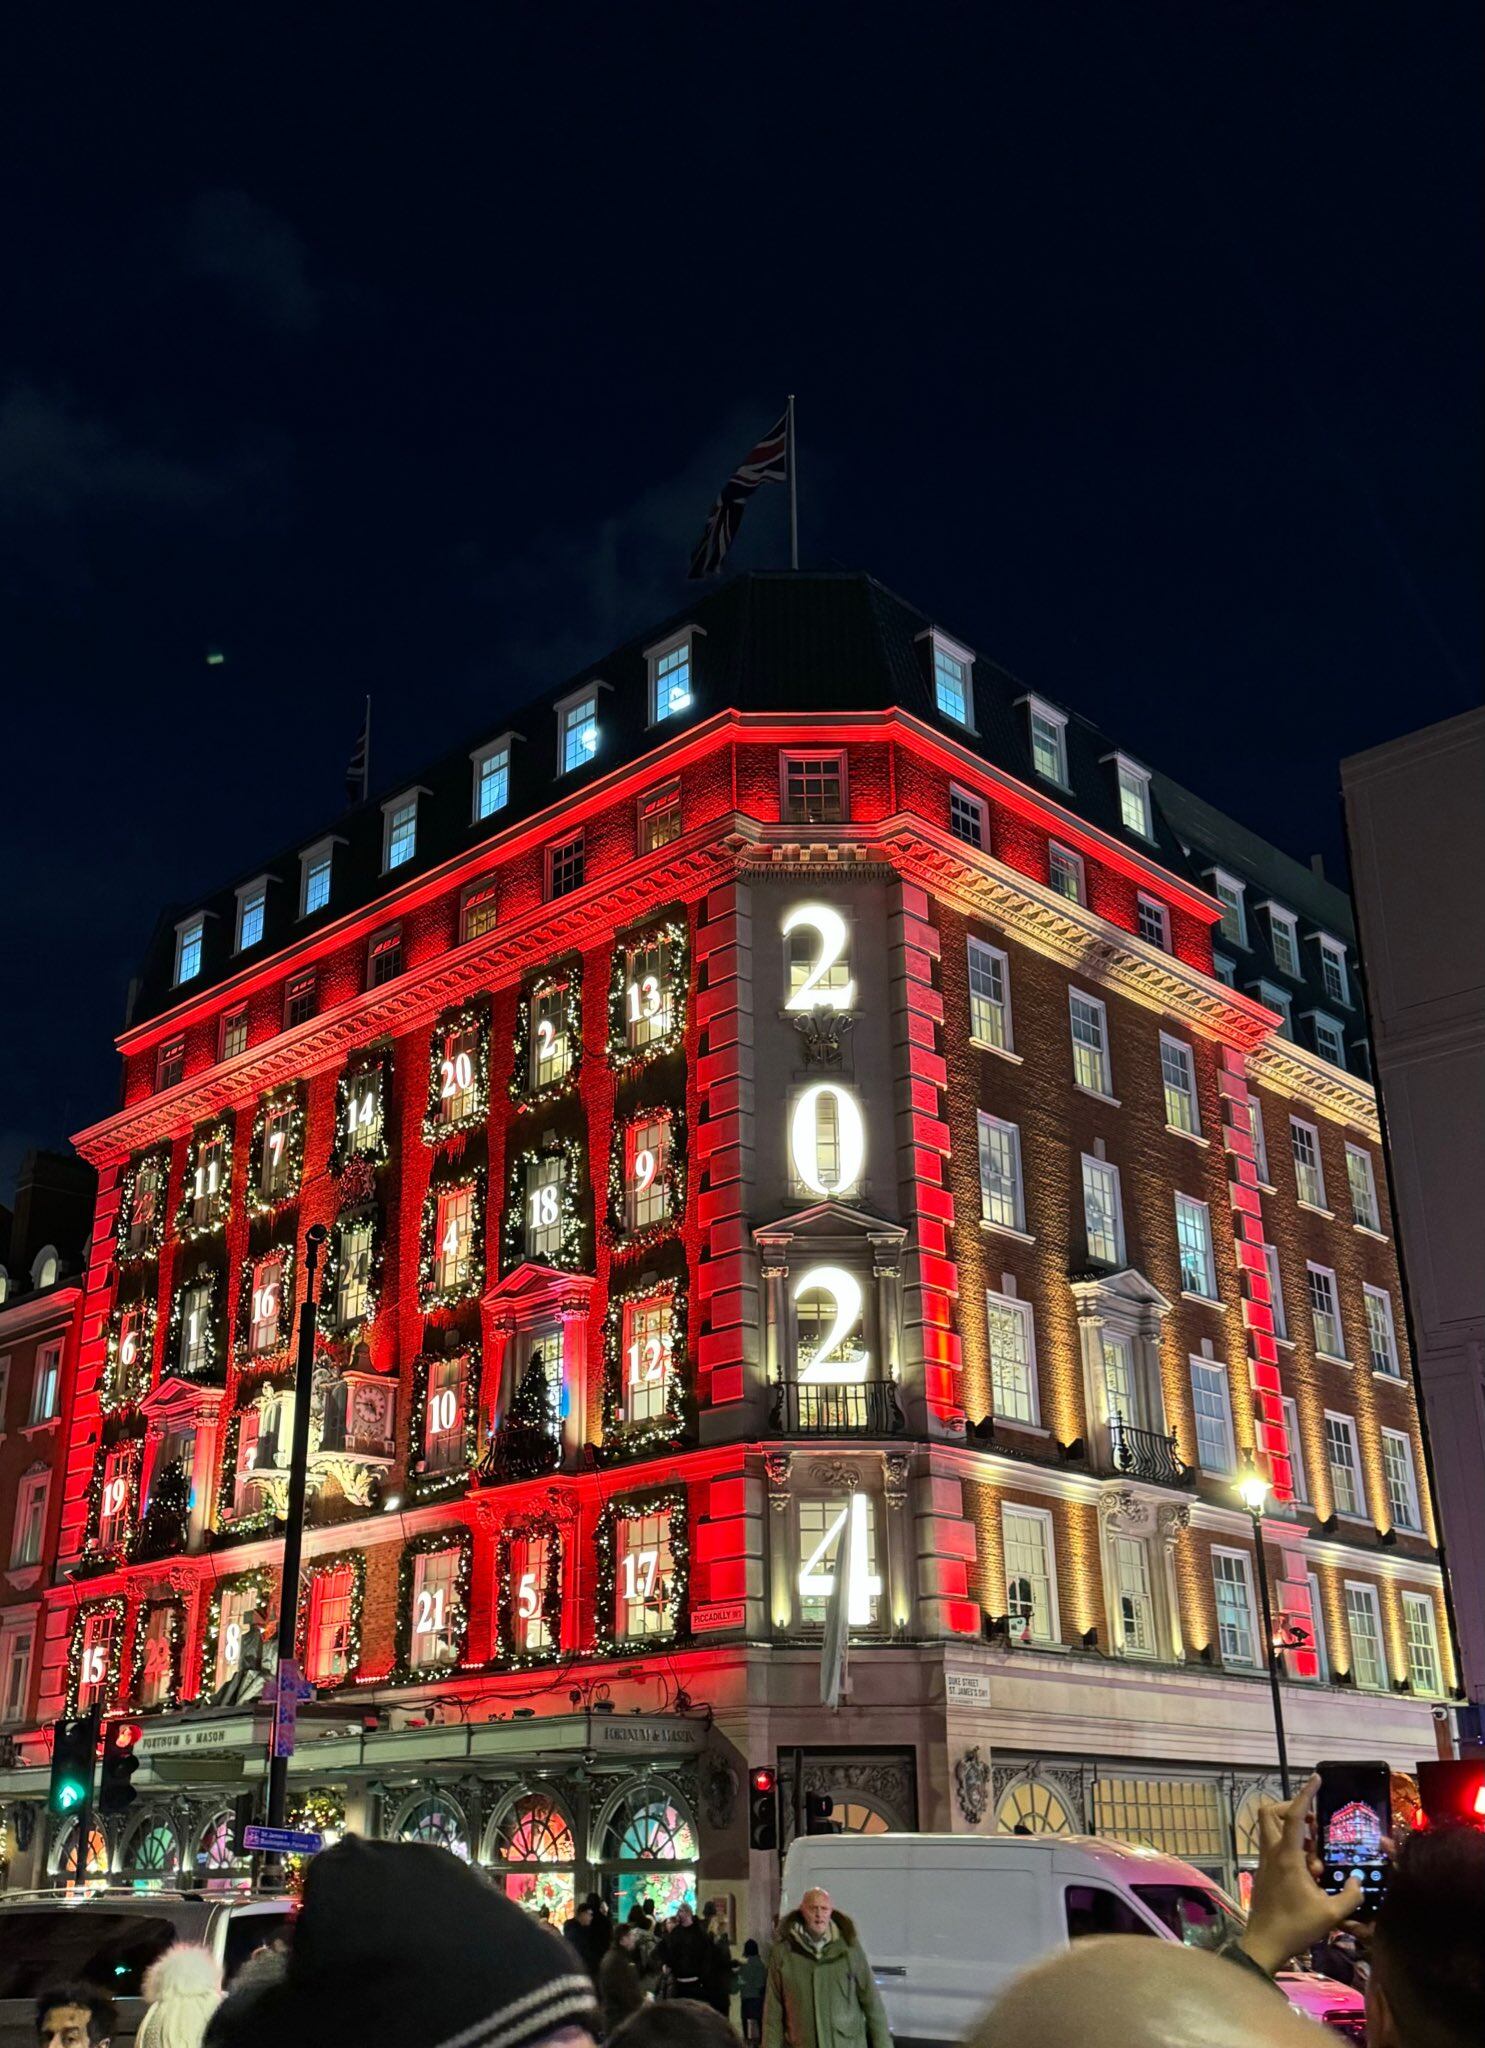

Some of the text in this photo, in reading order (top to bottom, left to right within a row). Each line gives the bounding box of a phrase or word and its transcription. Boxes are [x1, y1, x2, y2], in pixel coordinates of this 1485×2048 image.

[627, 976, 660, 1022] 13
[538, 1021, 557, 1060] 2
[441, 1053, 472, 1098] 20
[348, 1093, 373, 1133] 14
[270, 1132, 285, 1166] 7
[194, 1162, 220, 1200] 11
[635, 1151, 655, 1192] 9
[530, 1187, 559, 1230] 18
[442, 1221, 459, 1255] 4
[339, 1252, 369, 1291] 24
[252, 1284, 281, 1323] 16
[121, 1331, 136, 1365] 6
[189, 1314, 200, 1345] 1
[627, 1339, 665, 1385] 12
[429, 1391, 457, 1433] 10
[103, 1479, 126, 1517] 19
[518, 1573, 538, 1617] 5
[623, 1552, 659, 1599] 17
[417, 1589, 446, 1632] 21
[693, 1610, 731, 1622] PICCADILLY
[225, 1623, 240, 1663] 8
[82, 1650, 108, 1684] 15
[962, 1678, 979, 1687] STREET
[196, 1730, 225, 1743] MASON
